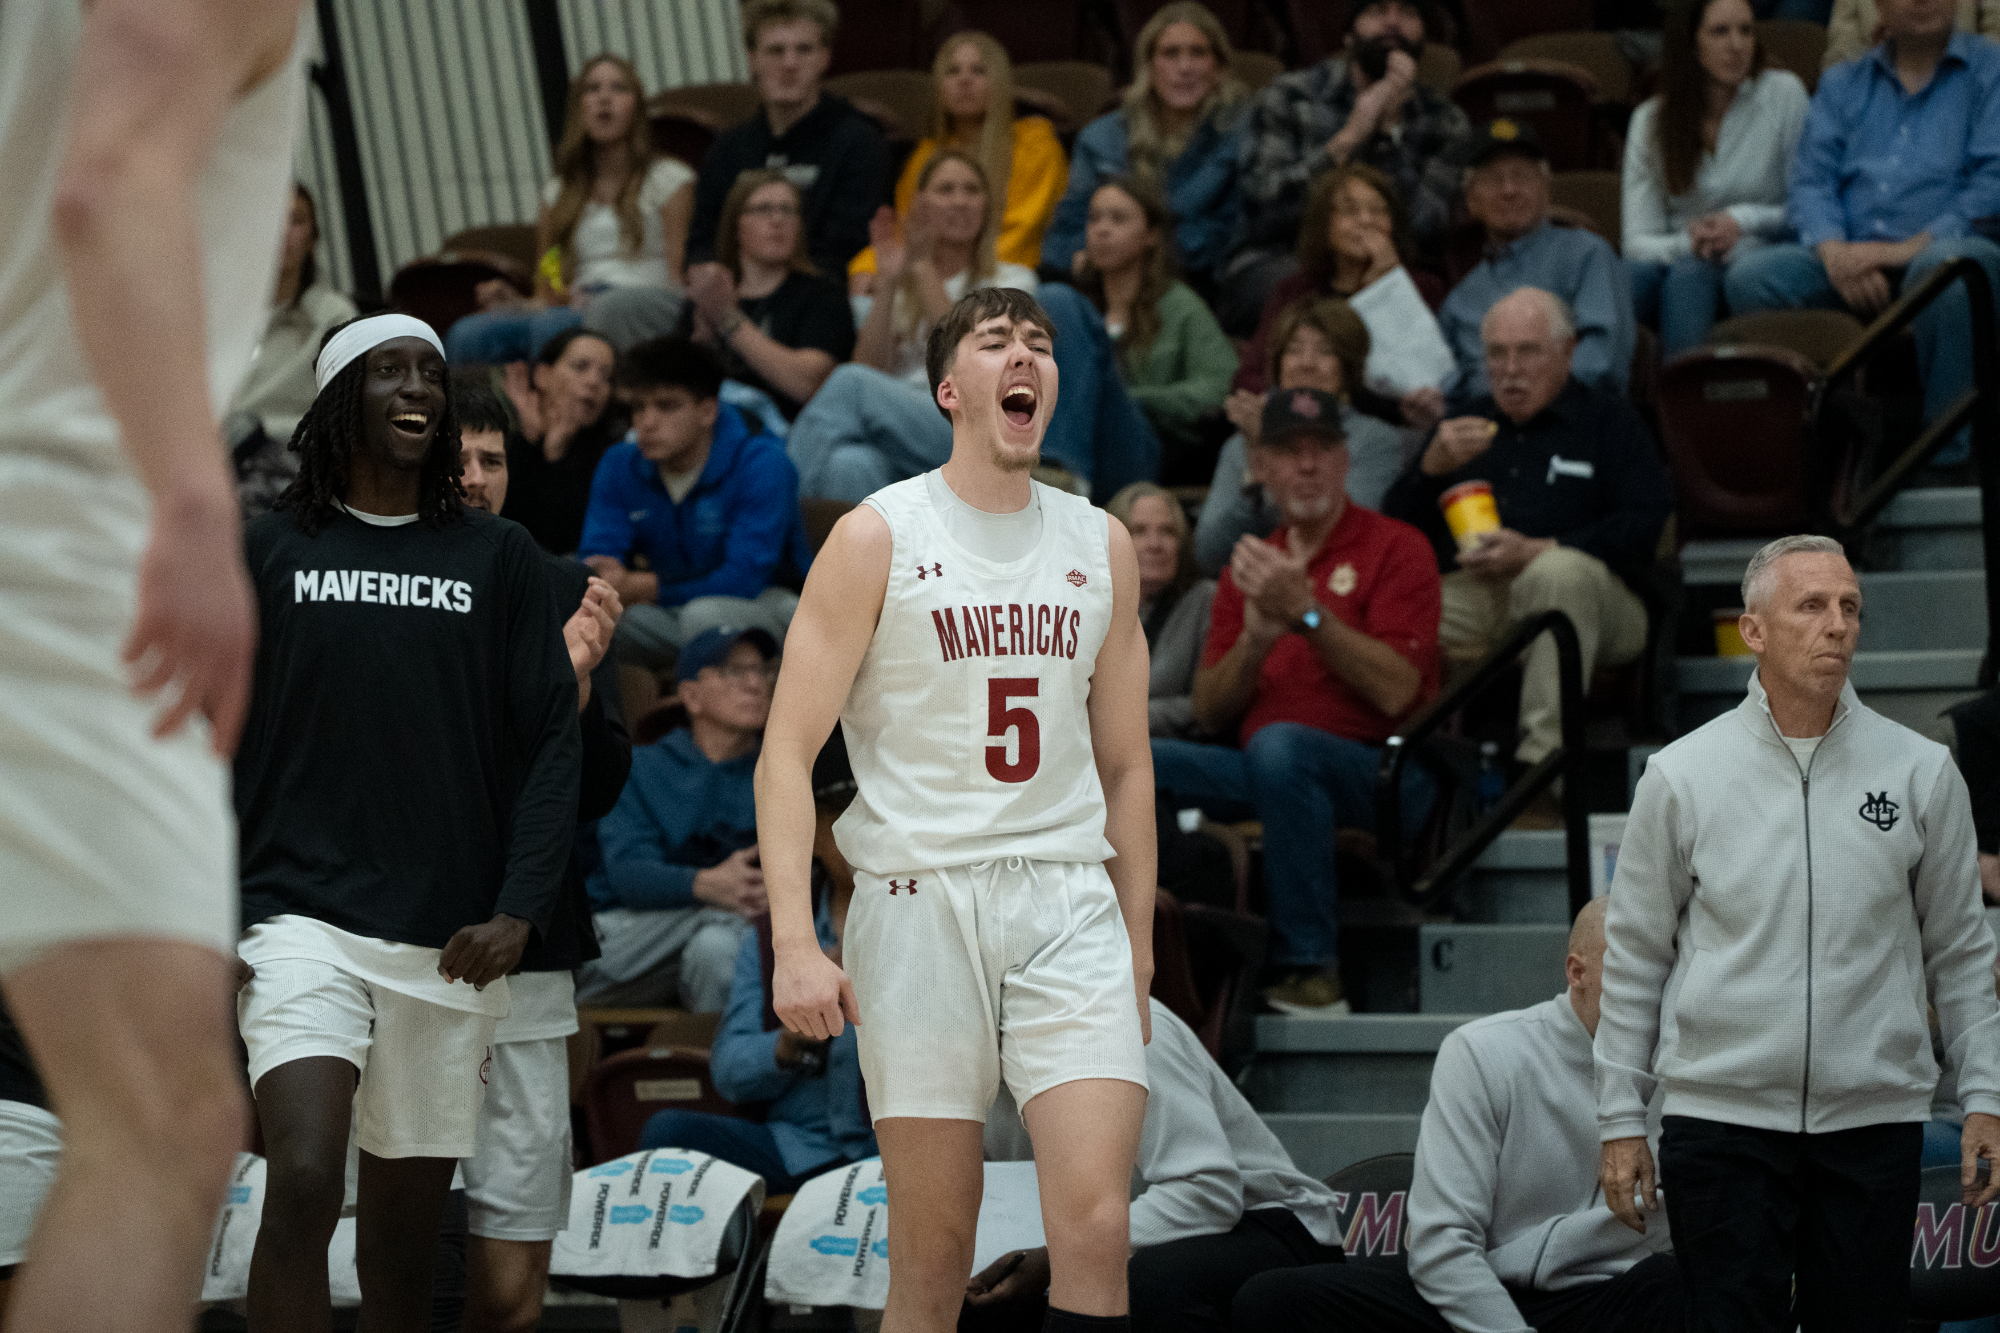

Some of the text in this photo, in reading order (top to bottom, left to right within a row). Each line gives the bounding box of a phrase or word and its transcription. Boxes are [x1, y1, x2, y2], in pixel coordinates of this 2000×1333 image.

[295, 570, 472, 614] MAVERICKS
[931, 604, 1081, 662] MAVERICKS
[985, 677, 1040, 783] 5
[1432, 938, 1453, 971] C
[588, 1184, 610, 1250] POWERADE
[649, 1182, 672, 1250] POWERADE
[1910, 1203, 2000, 1270] MU
